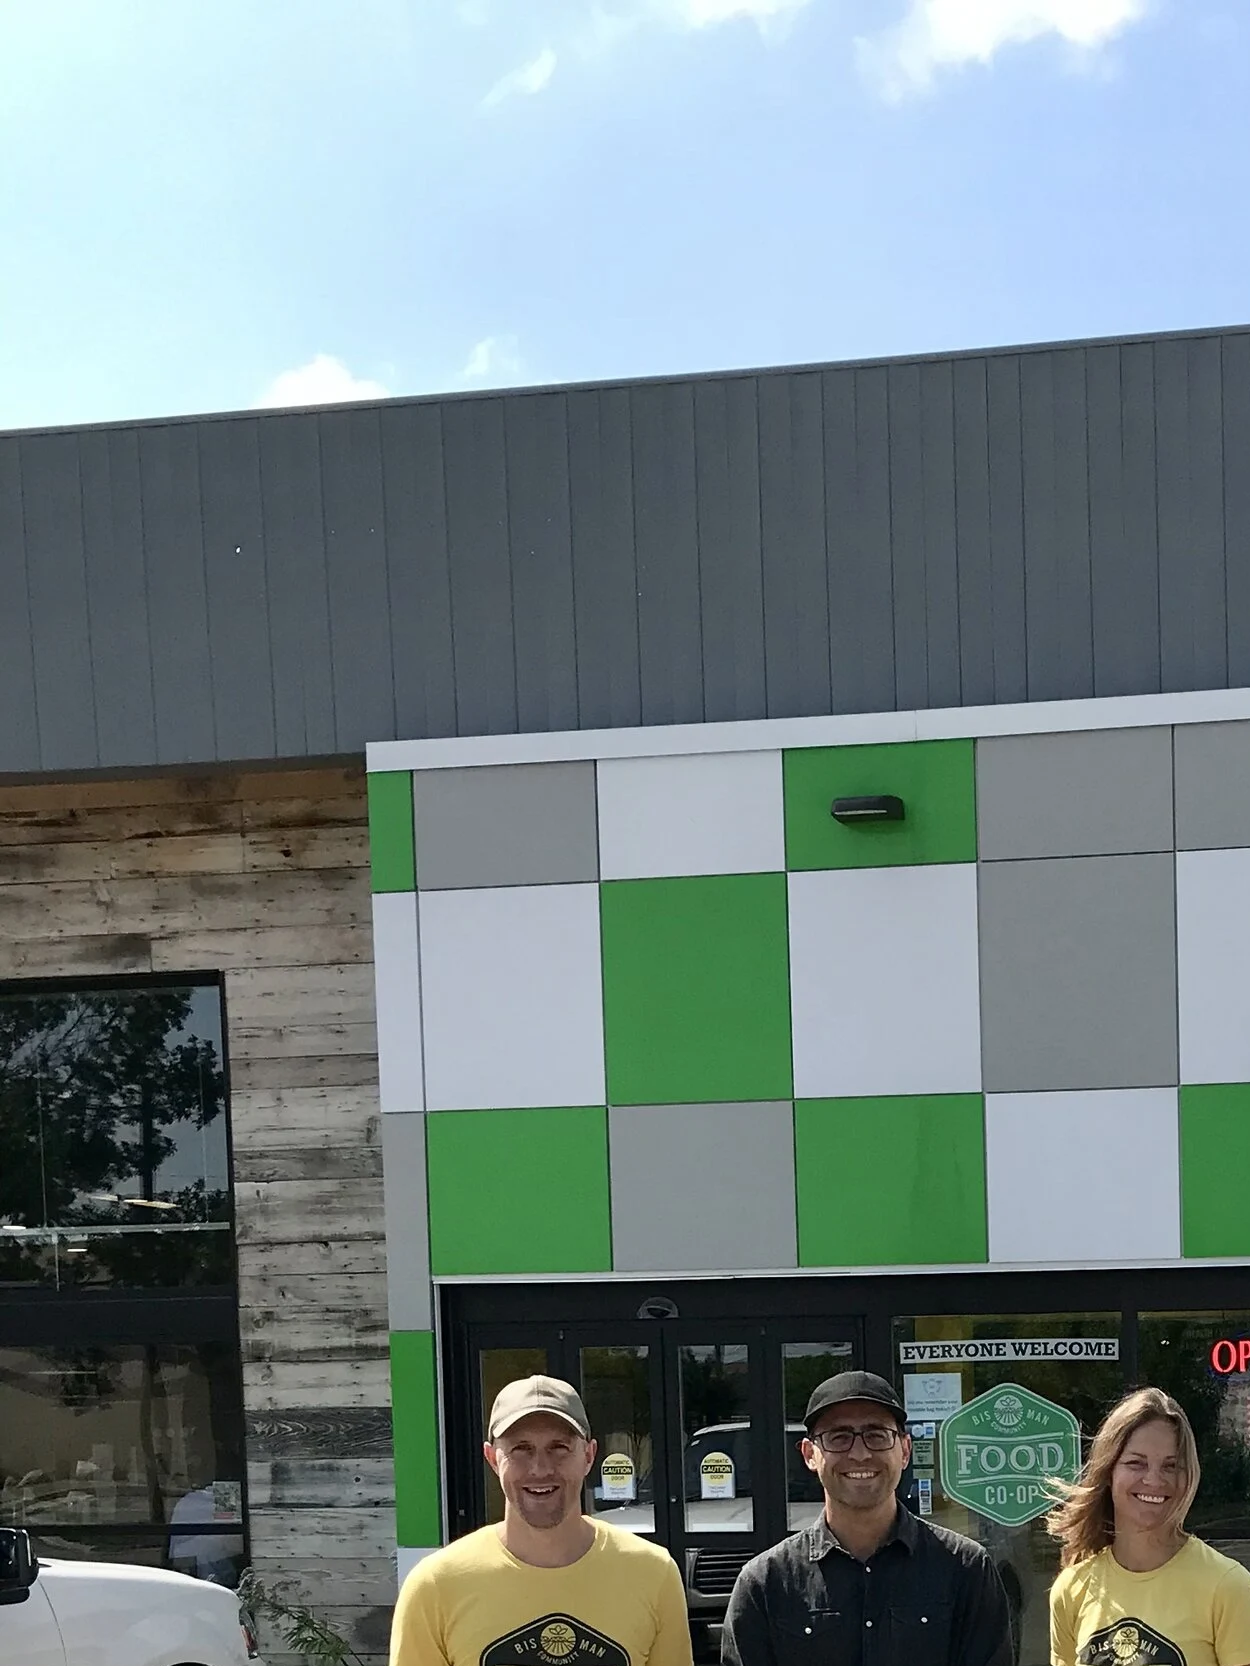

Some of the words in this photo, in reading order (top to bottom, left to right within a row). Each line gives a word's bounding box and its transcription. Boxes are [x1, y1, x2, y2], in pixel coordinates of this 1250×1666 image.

[902, 1341, 1007, 1361] EVERYONE
[1011, 1340, 1117, 1357] WELCOME
[972, 1410, 991, 1426] BIS
[1026, 1408, 1050, 1426] MAN
[956, 1442, 1064, 1475] FOOD
[603, 1467, 632, 1475] CAUTION
[702, 1465, 732, 1473] CAUTION
[985, 1485, 1039, 1505] CO-OP
[514, 1638, 538, 1654] BIS
[579, 1639, 607, 1658] MAN
[1139, 1639, 1160, 1656] MAN
[537, 1650, 580, 1666] COMMUNITY
